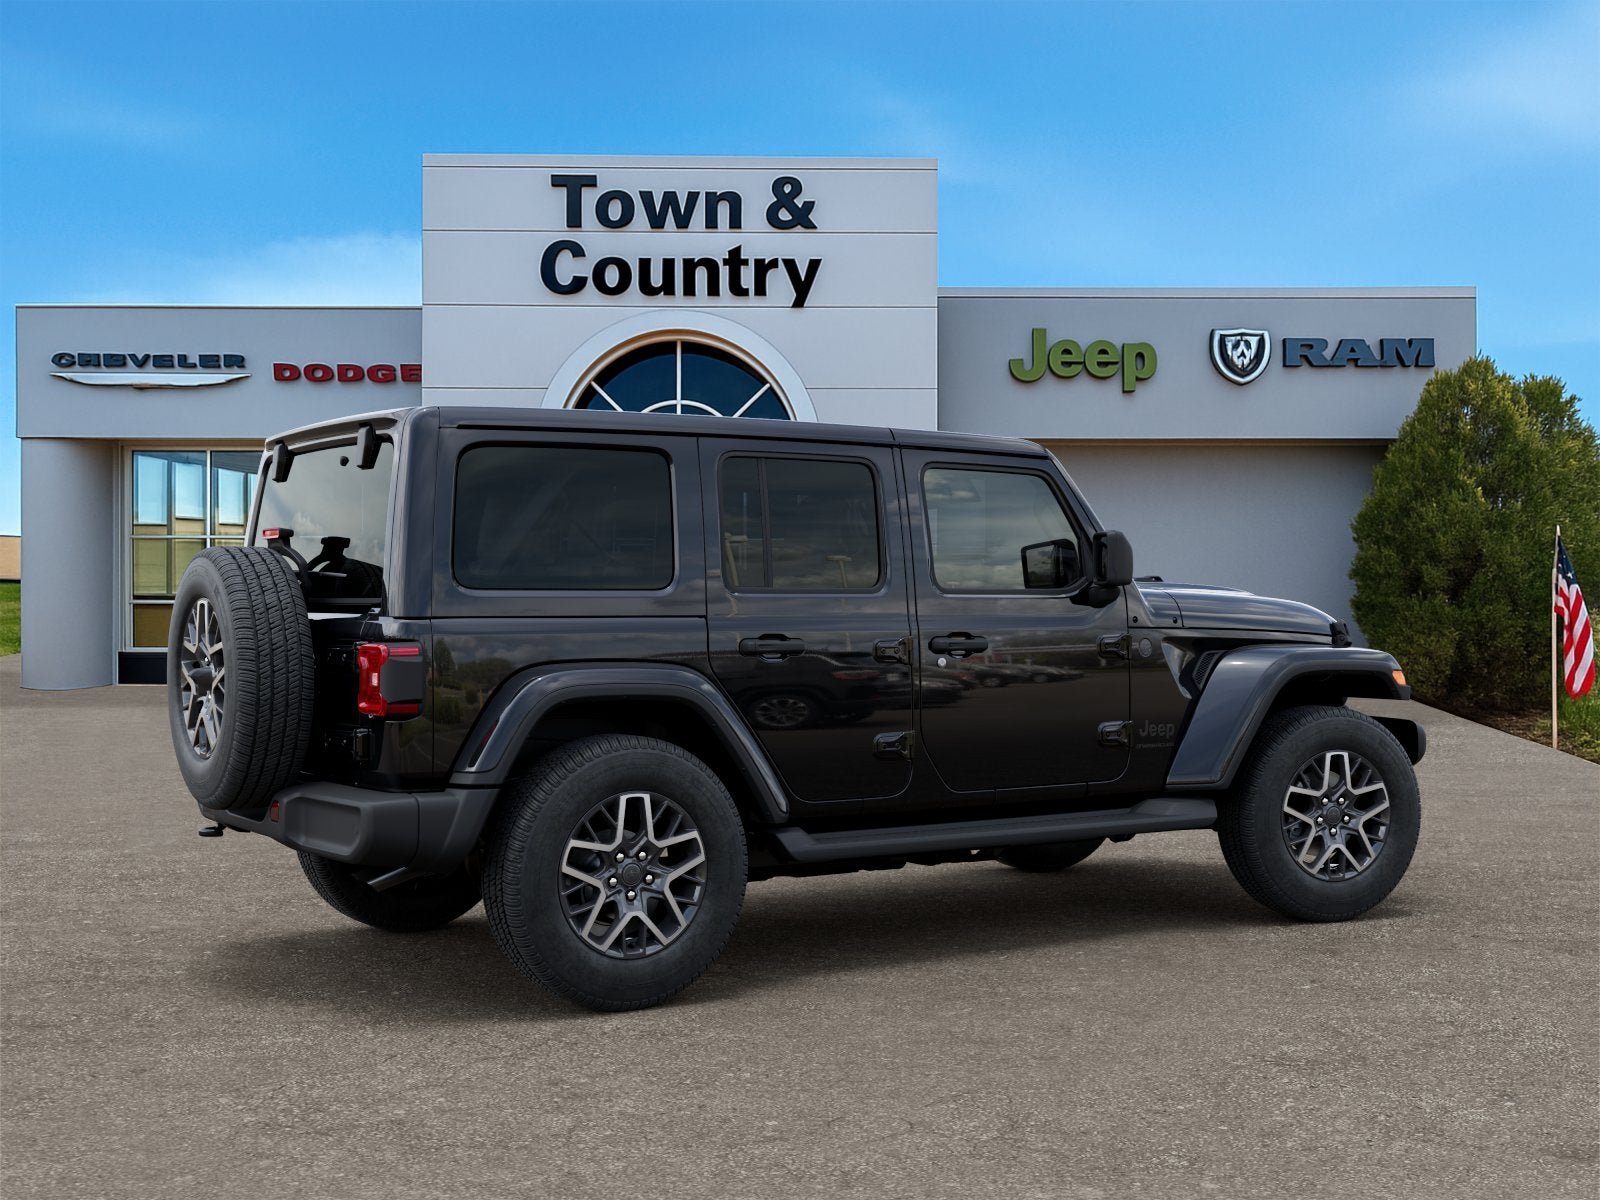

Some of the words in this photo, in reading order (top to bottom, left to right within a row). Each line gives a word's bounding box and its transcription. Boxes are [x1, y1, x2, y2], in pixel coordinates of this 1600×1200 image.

[550, 174, 743, 230] Town
[765, 176, 818, 230] &
[540, 240, 822, 308] Country
[272, 362, 422, 383] DODGE
[1008, 328, 1158, 393] Jeep
[1282, 337, 1435, 368] RAM
[1138, 720, 1175, 739] Jeep
